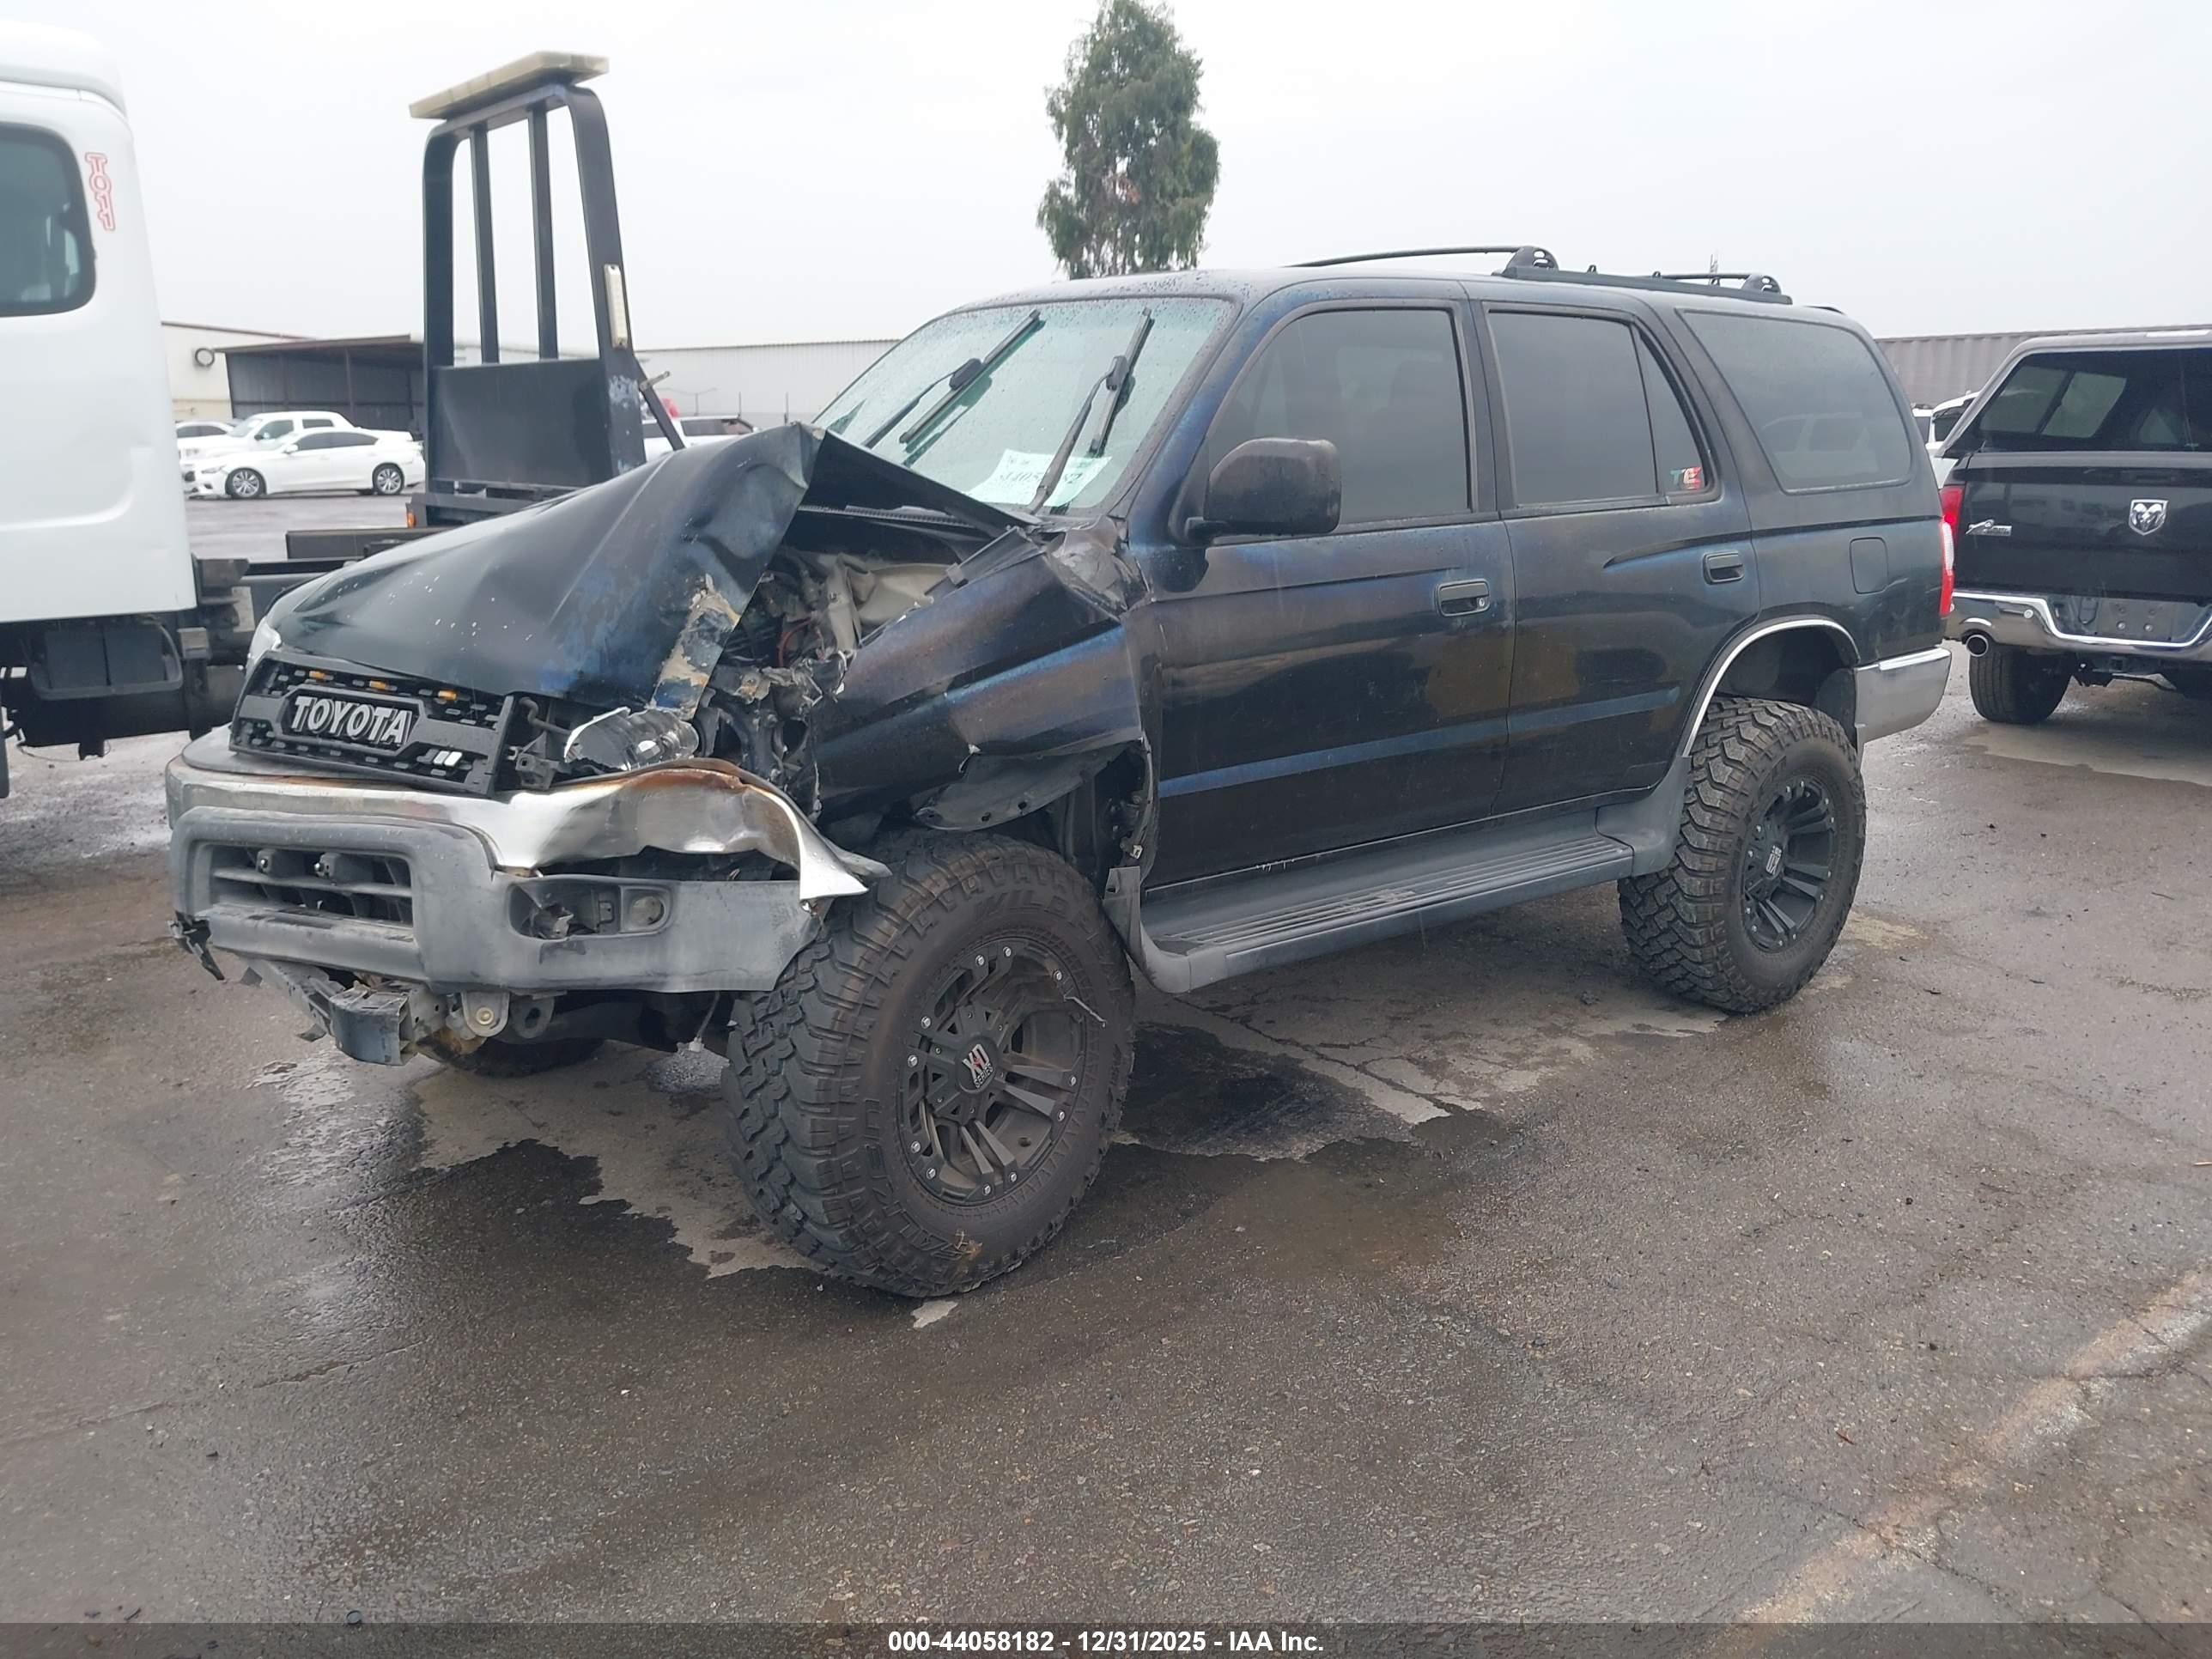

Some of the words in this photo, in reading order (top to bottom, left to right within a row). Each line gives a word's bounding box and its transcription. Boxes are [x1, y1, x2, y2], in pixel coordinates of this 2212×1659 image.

[290, 696, 413, 746] TOYOTA
[962, 1043, 990, 1085] XD
[974, 1063, 994, 1089] SERIES
